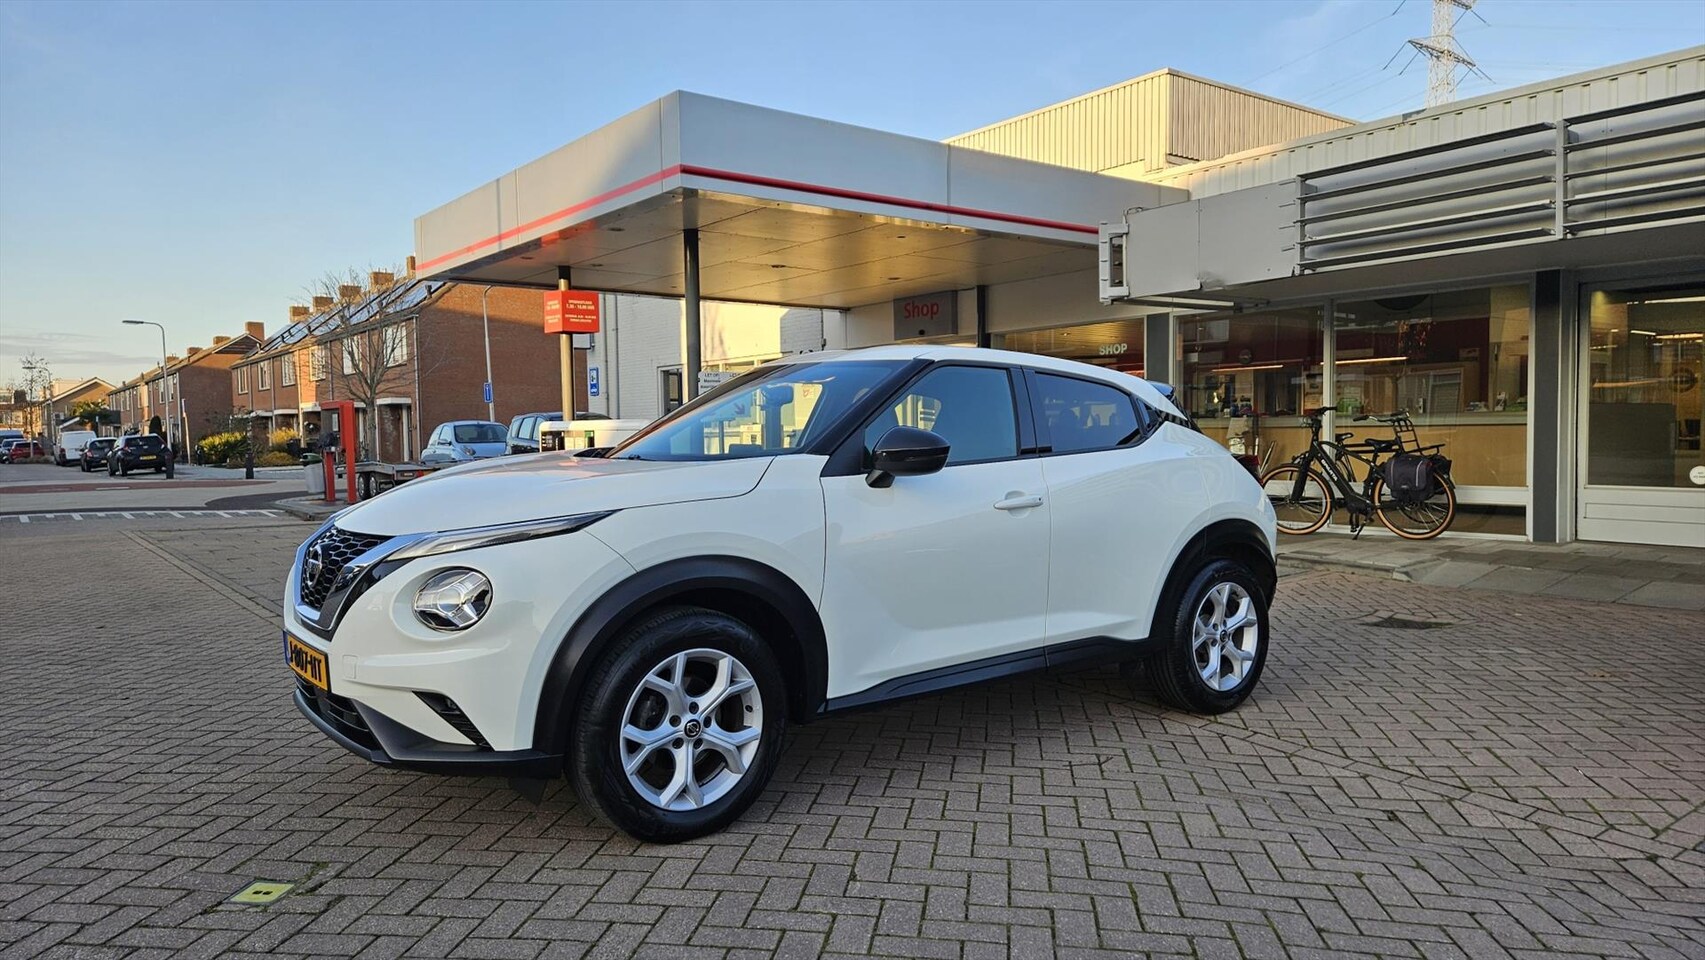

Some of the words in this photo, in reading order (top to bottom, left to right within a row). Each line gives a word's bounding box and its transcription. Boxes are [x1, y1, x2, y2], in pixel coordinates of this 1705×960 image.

[904, 300, 939, 320] Shop
[1099, 343, 1128, 355] SHOP
[1321, 459, 1338, 481] SPARTA
